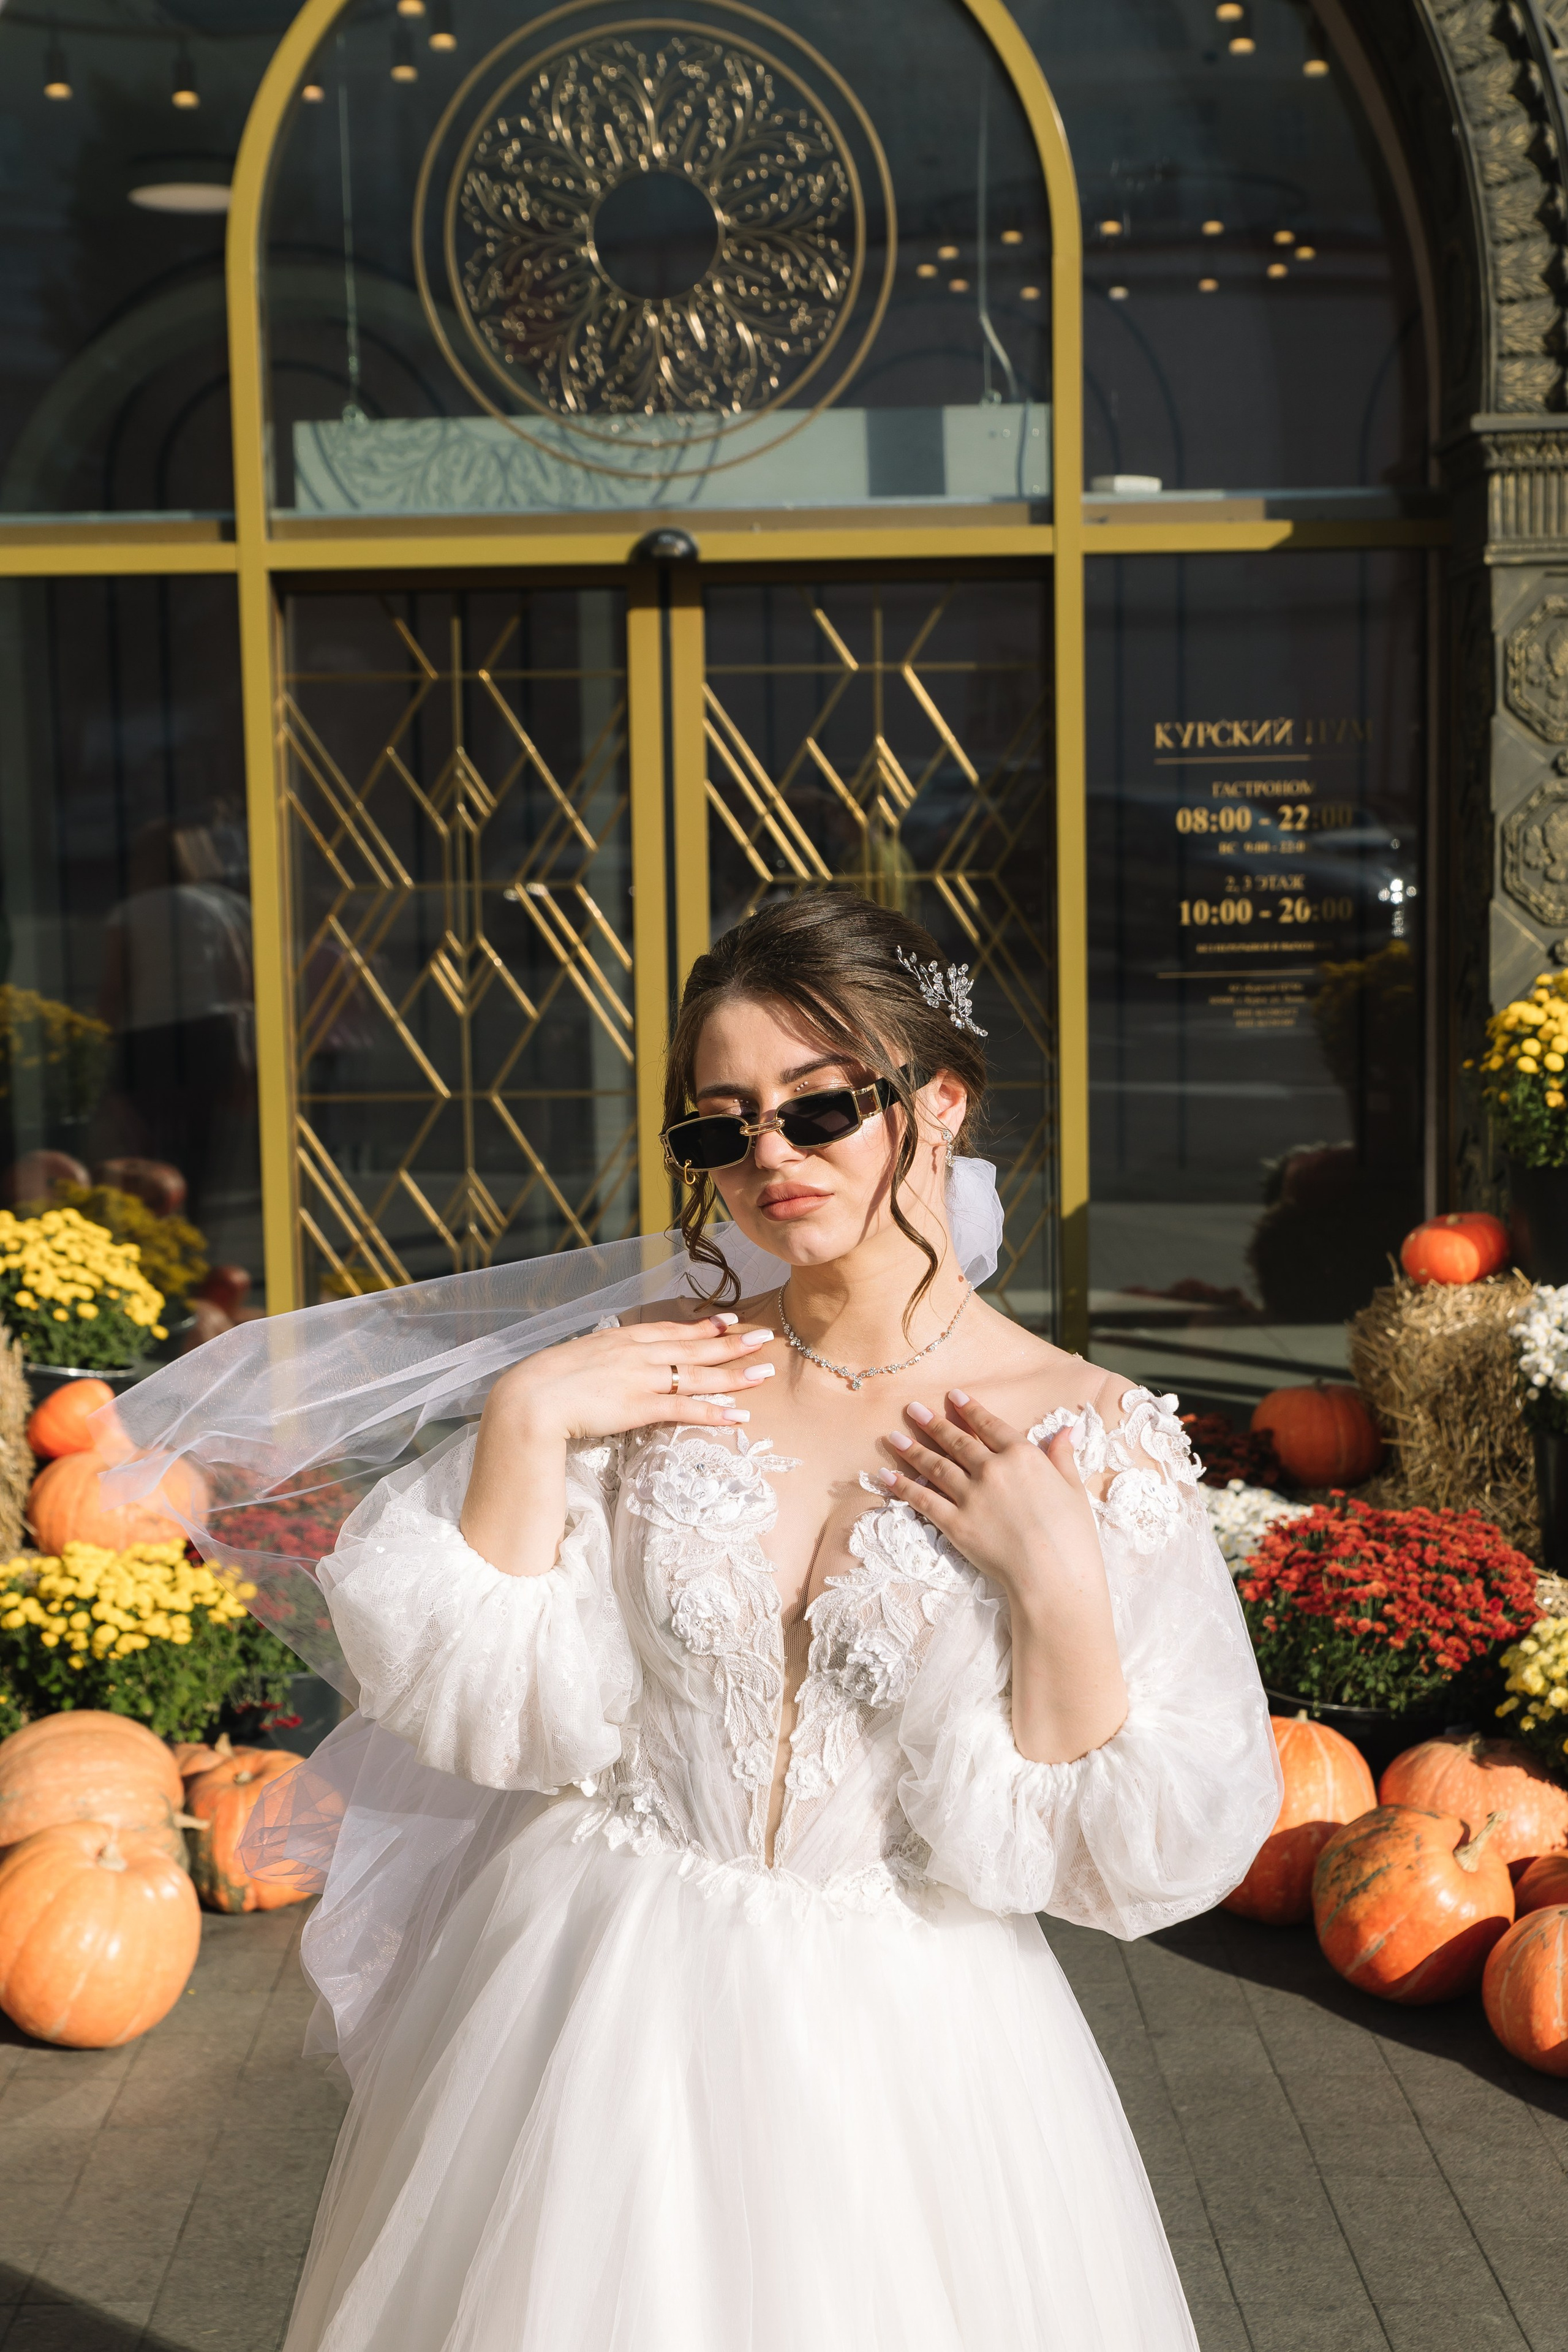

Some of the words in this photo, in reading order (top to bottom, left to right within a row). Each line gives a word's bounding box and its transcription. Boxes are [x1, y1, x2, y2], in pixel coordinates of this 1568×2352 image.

[1155, 717, 1294, 749] КУРСКИЙ
[1212, 779, 1315, 798] ГАСТРОНОМ
[1175, 806, 1253, 834] 08:00
[1278, 804, 1352, 831] 22:00
[1279, 839, 1311, 854] 22:0
[1224, 875, 1240, 894] 2,
[1242, 875, 1253, 892] 3
[1254, 874, 1306, 892] ЭТАЖ
[1179, 898, 1253, 926] 10:00
[1278, 896, 1352, 924] 20:00
